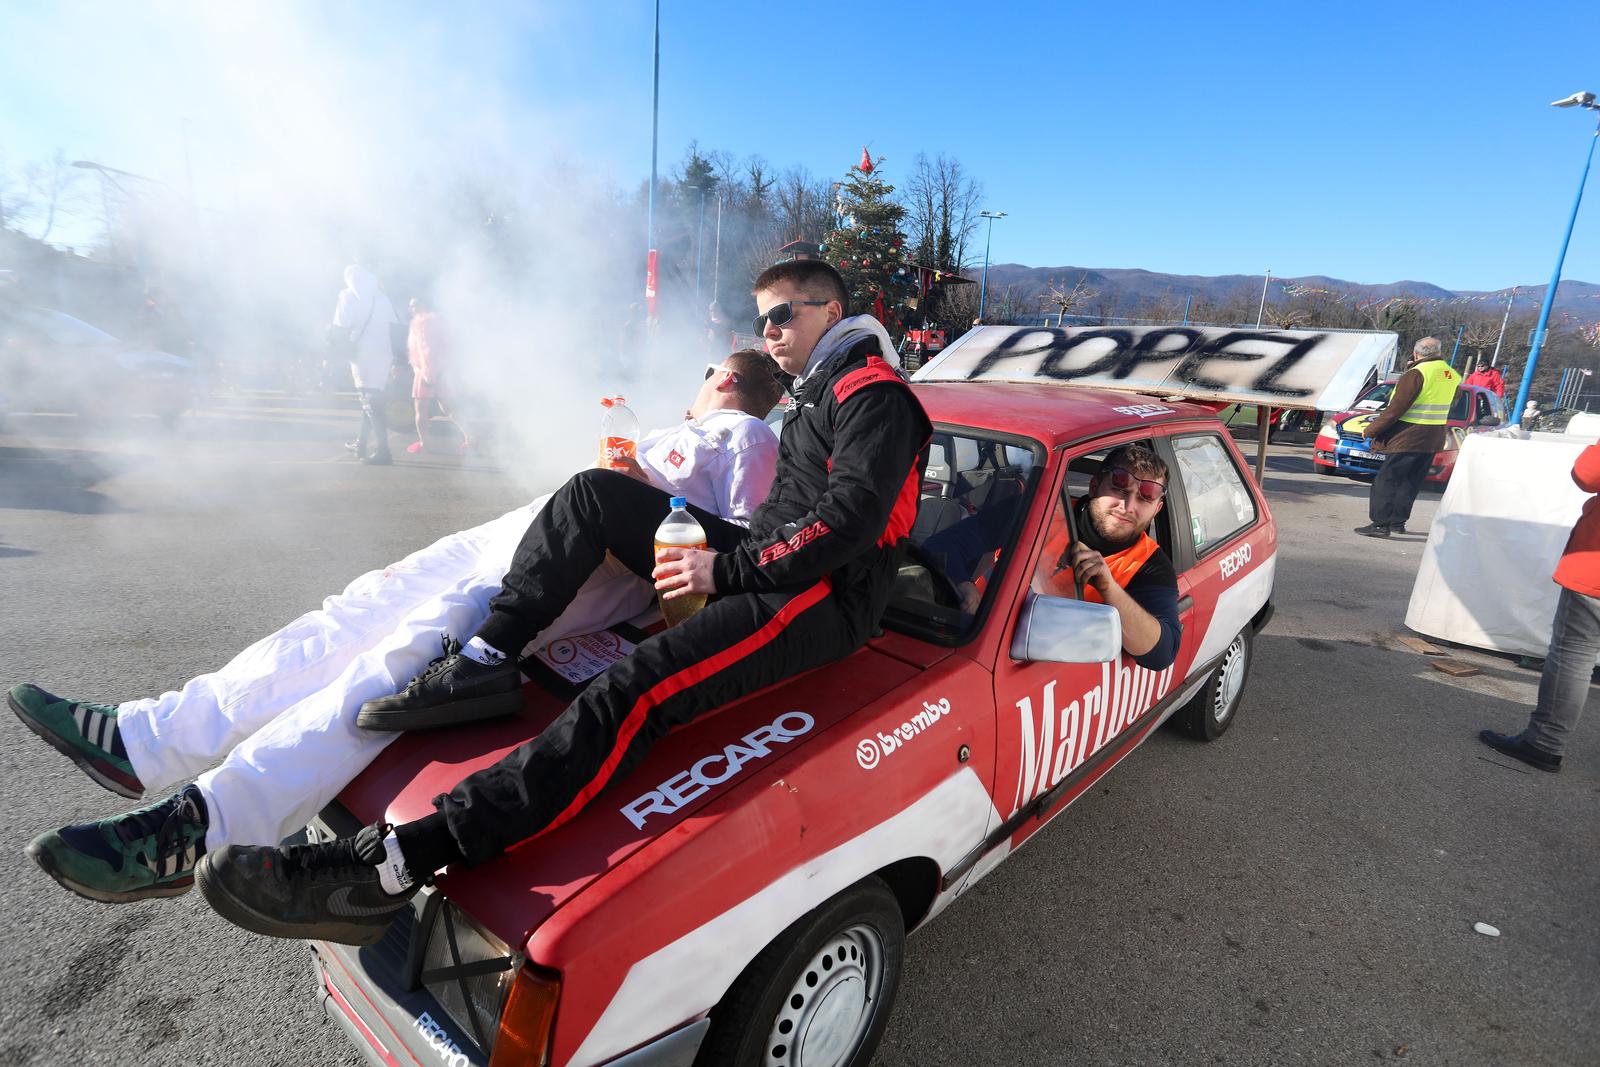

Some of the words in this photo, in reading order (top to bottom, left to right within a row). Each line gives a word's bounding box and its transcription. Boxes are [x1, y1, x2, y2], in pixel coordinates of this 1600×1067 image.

[1218, 542, 1252, 581] RECARO
[876, 697, 951, 757] brembo
[619, 711, 815, 831] RECARO
[412, 1011, 470, 1067] RECARO
